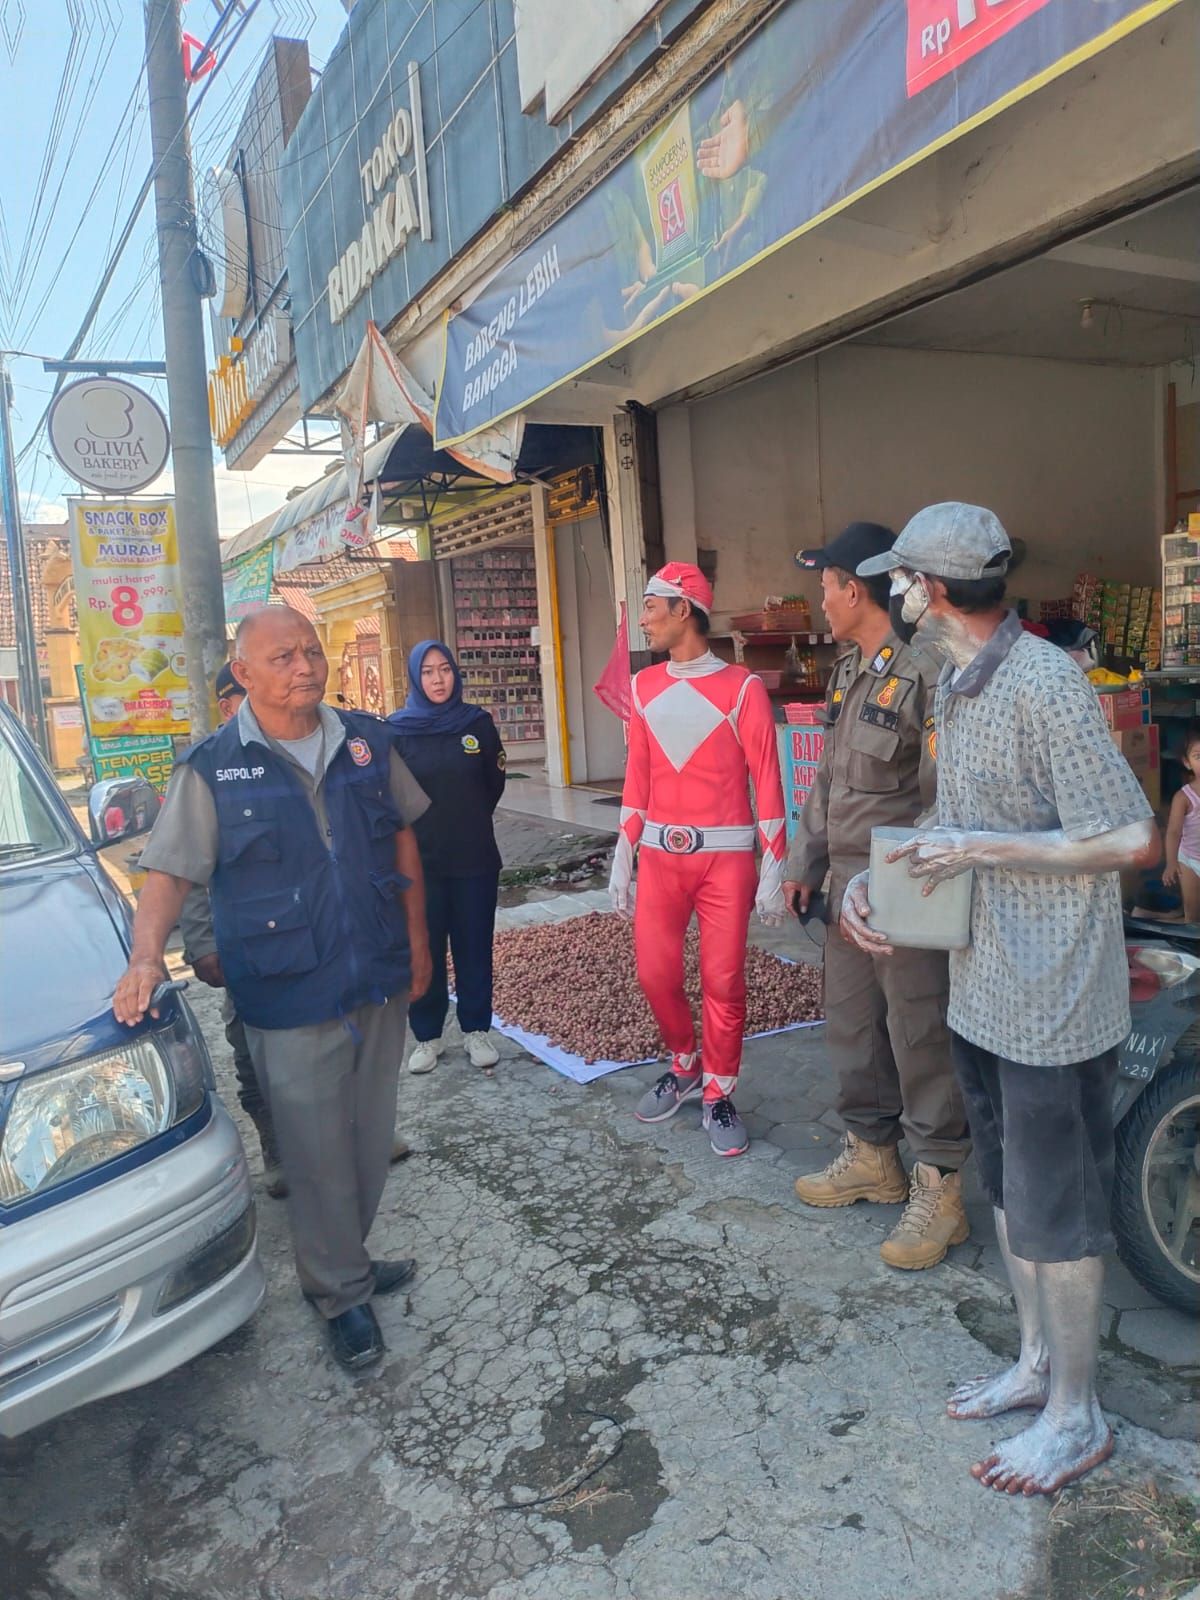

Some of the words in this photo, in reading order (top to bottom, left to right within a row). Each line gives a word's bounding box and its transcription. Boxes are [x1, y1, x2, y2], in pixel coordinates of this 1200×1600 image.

[921, 17, 950, 58] Rp
[361, 108, 412, 205] TOKO
[328, 174, 420, 325] RIDAKA
[464, 295, 516, 373] BARENG
[518, 244, 561, 319] LEBIH
[462, 338, 518, 413] BANGGA
[74, 436, 149, 465] OLIVIA
[83, 457, 141, 472] BAKERY
[84, 511, 135, 526] SNACK
[139, 511, 167, 526] BOX
[99, 543, 162, 556] MURAH
[92, 576, 123, 585] mulai
[216, 767, 252, 781] SATPOL
[252, 766, 265, 780] PP
